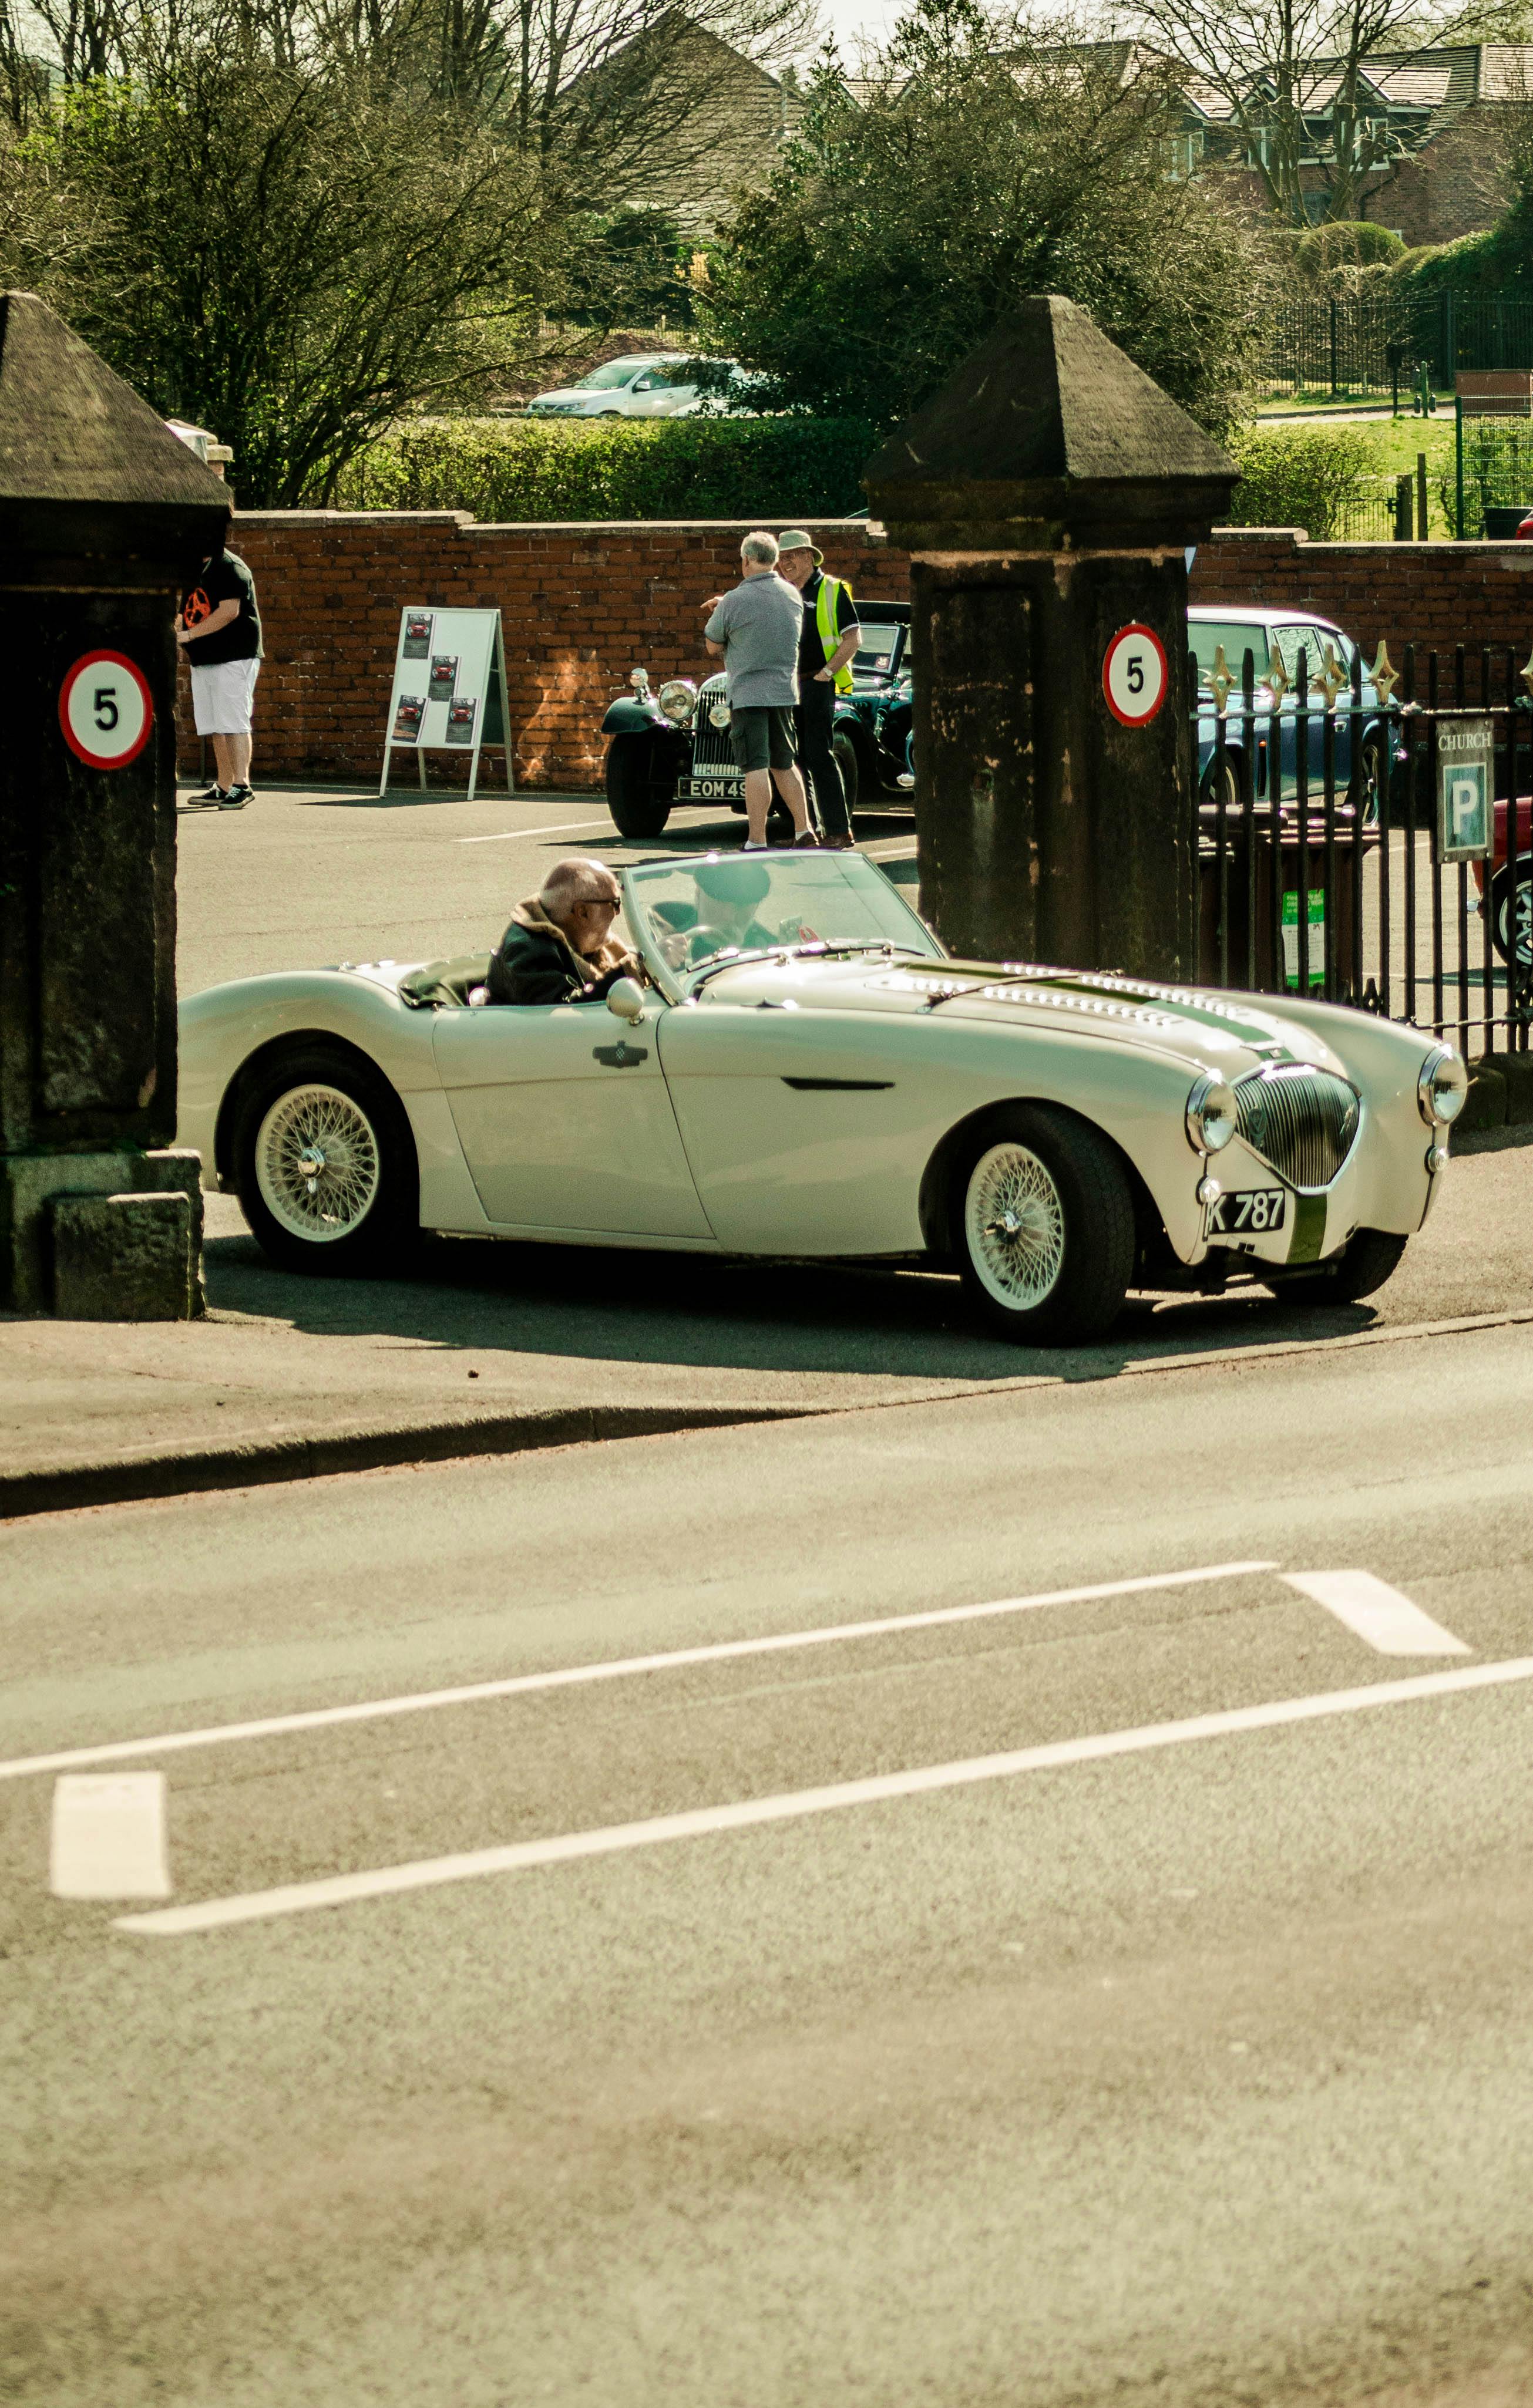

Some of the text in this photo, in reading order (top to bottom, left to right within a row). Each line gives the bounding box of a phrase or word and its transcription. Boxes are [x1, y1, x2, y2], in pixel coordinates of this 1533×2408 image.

[1127, 656, 1144, 694] 5
[94, 688, 118, 731] 5
[1438, 732, 1492, 751] CHURCH
[690, 780, 724, 797] EOM
[1453, 779, 1479, 834] P
[1234, 1190, 1284, 1230] 787
